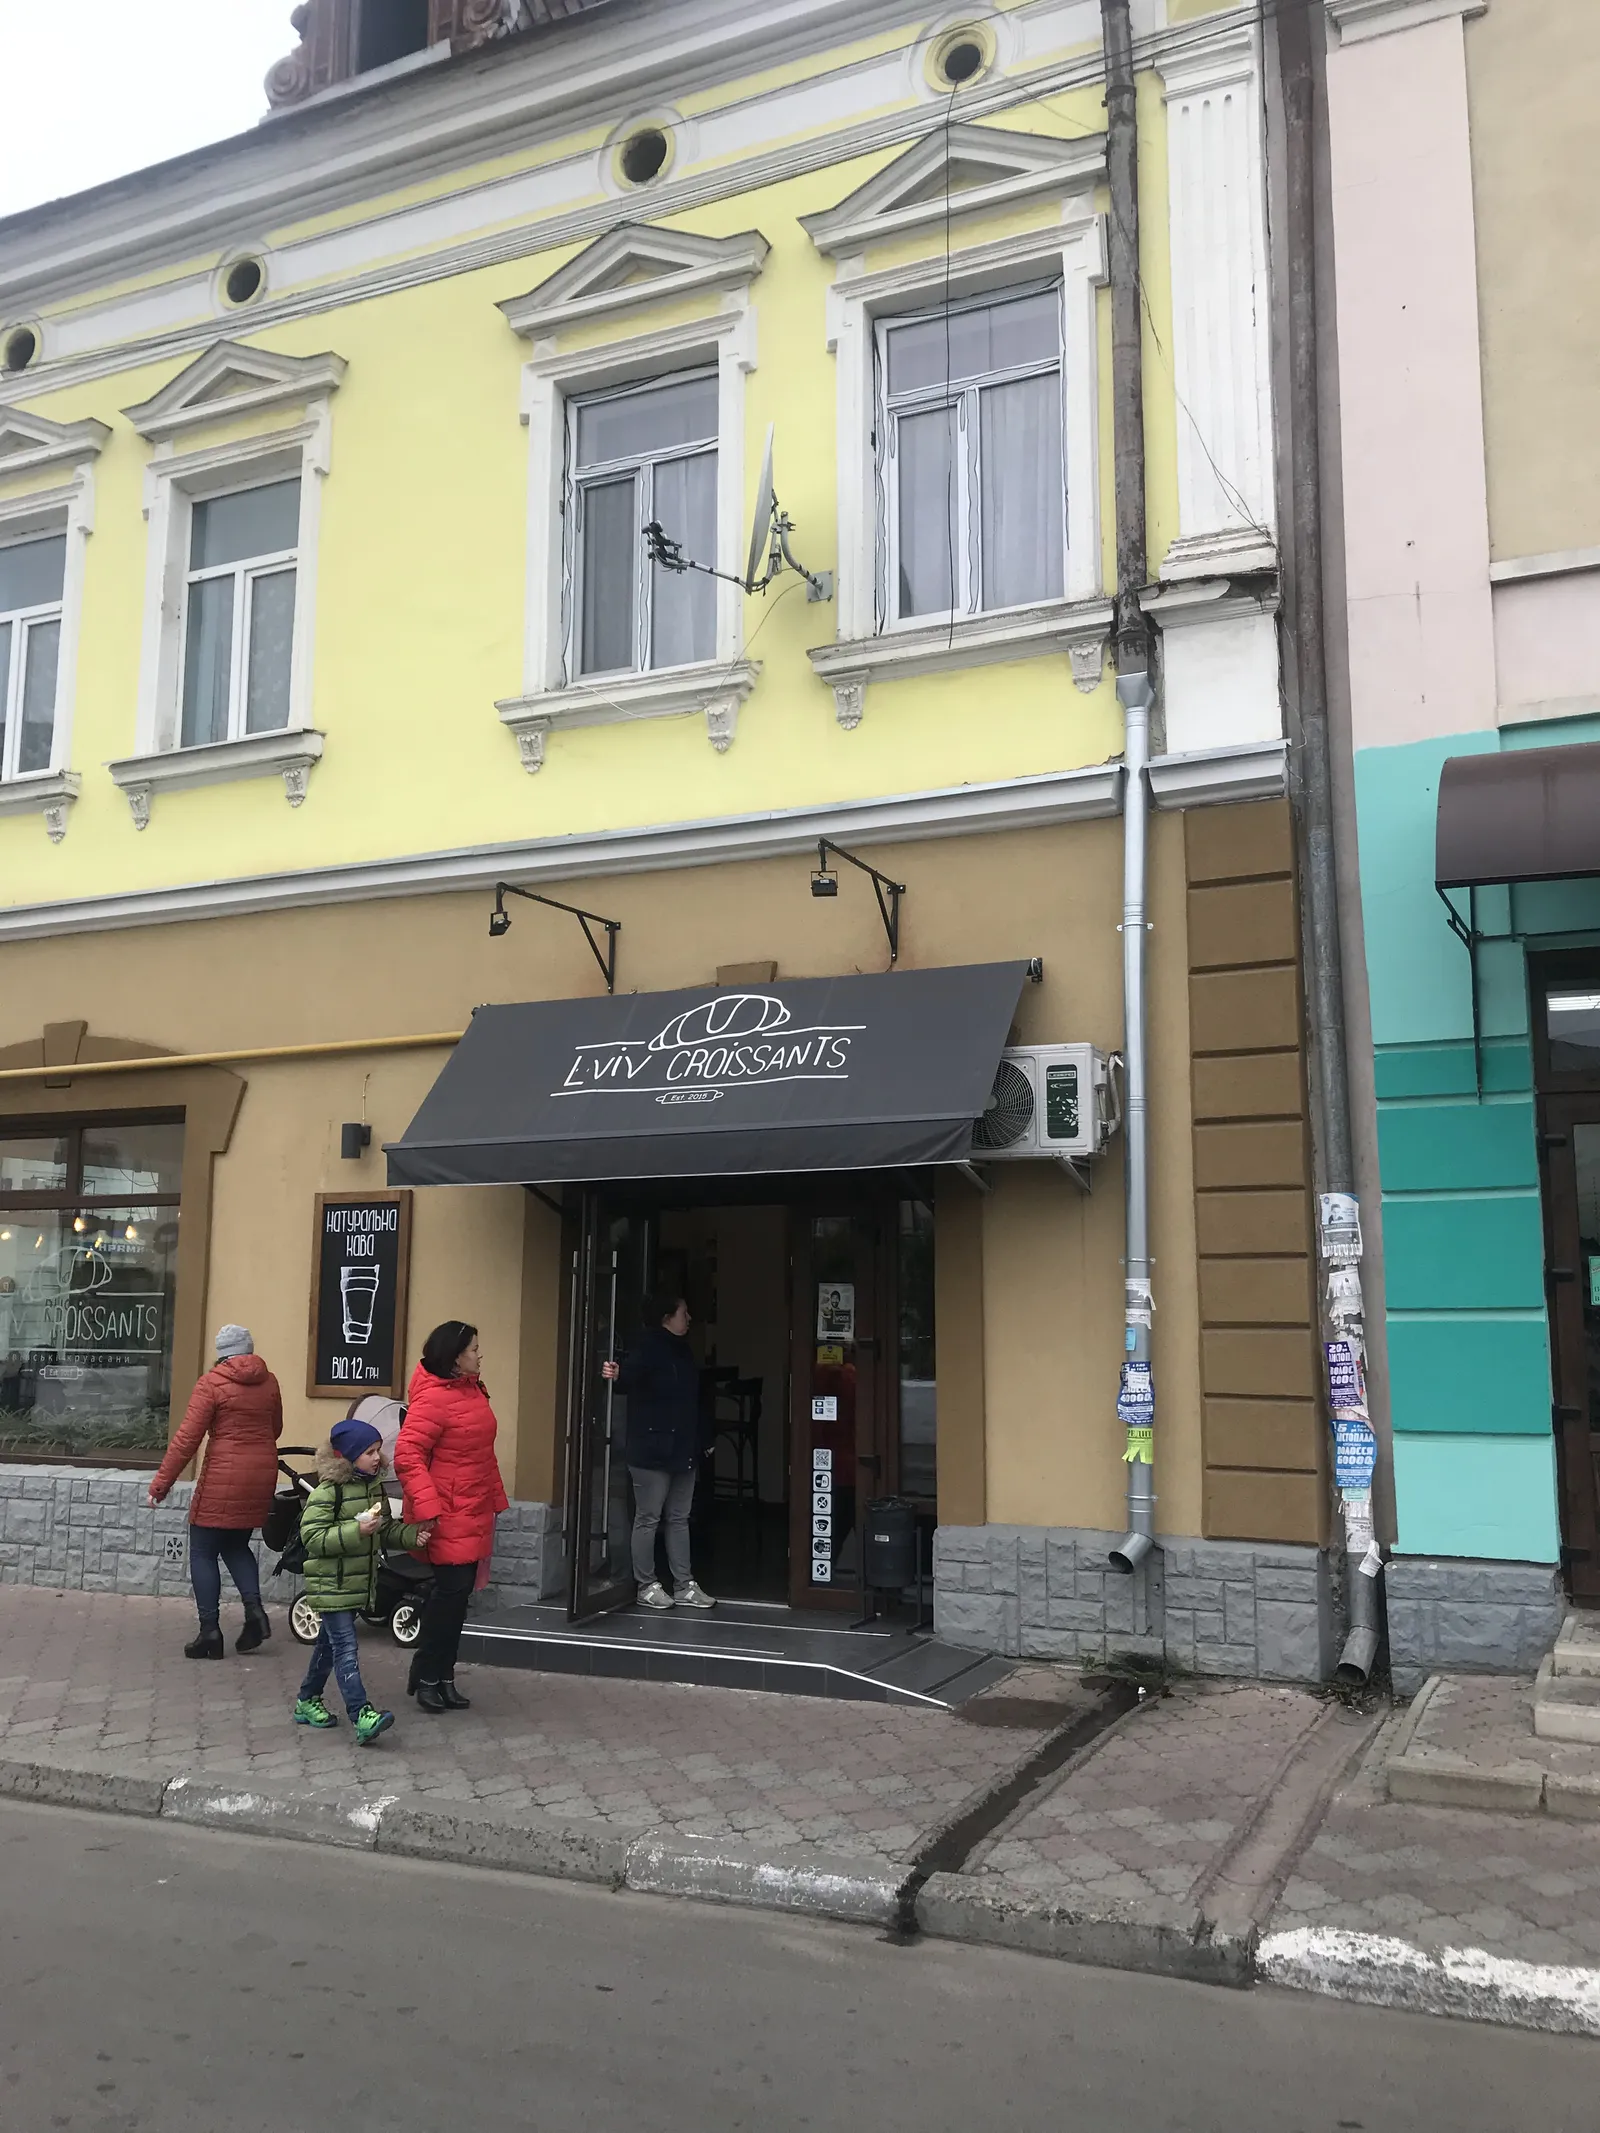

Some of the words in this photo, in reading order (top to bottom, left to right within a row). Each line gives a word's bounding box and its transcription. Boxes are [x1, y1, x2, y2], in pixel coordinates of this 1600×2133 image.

[346, 1234, 375, 1257] КАВА
[332, 1356, 349, 1379] ВІД
[351, 1356, 364, 1379] 12
